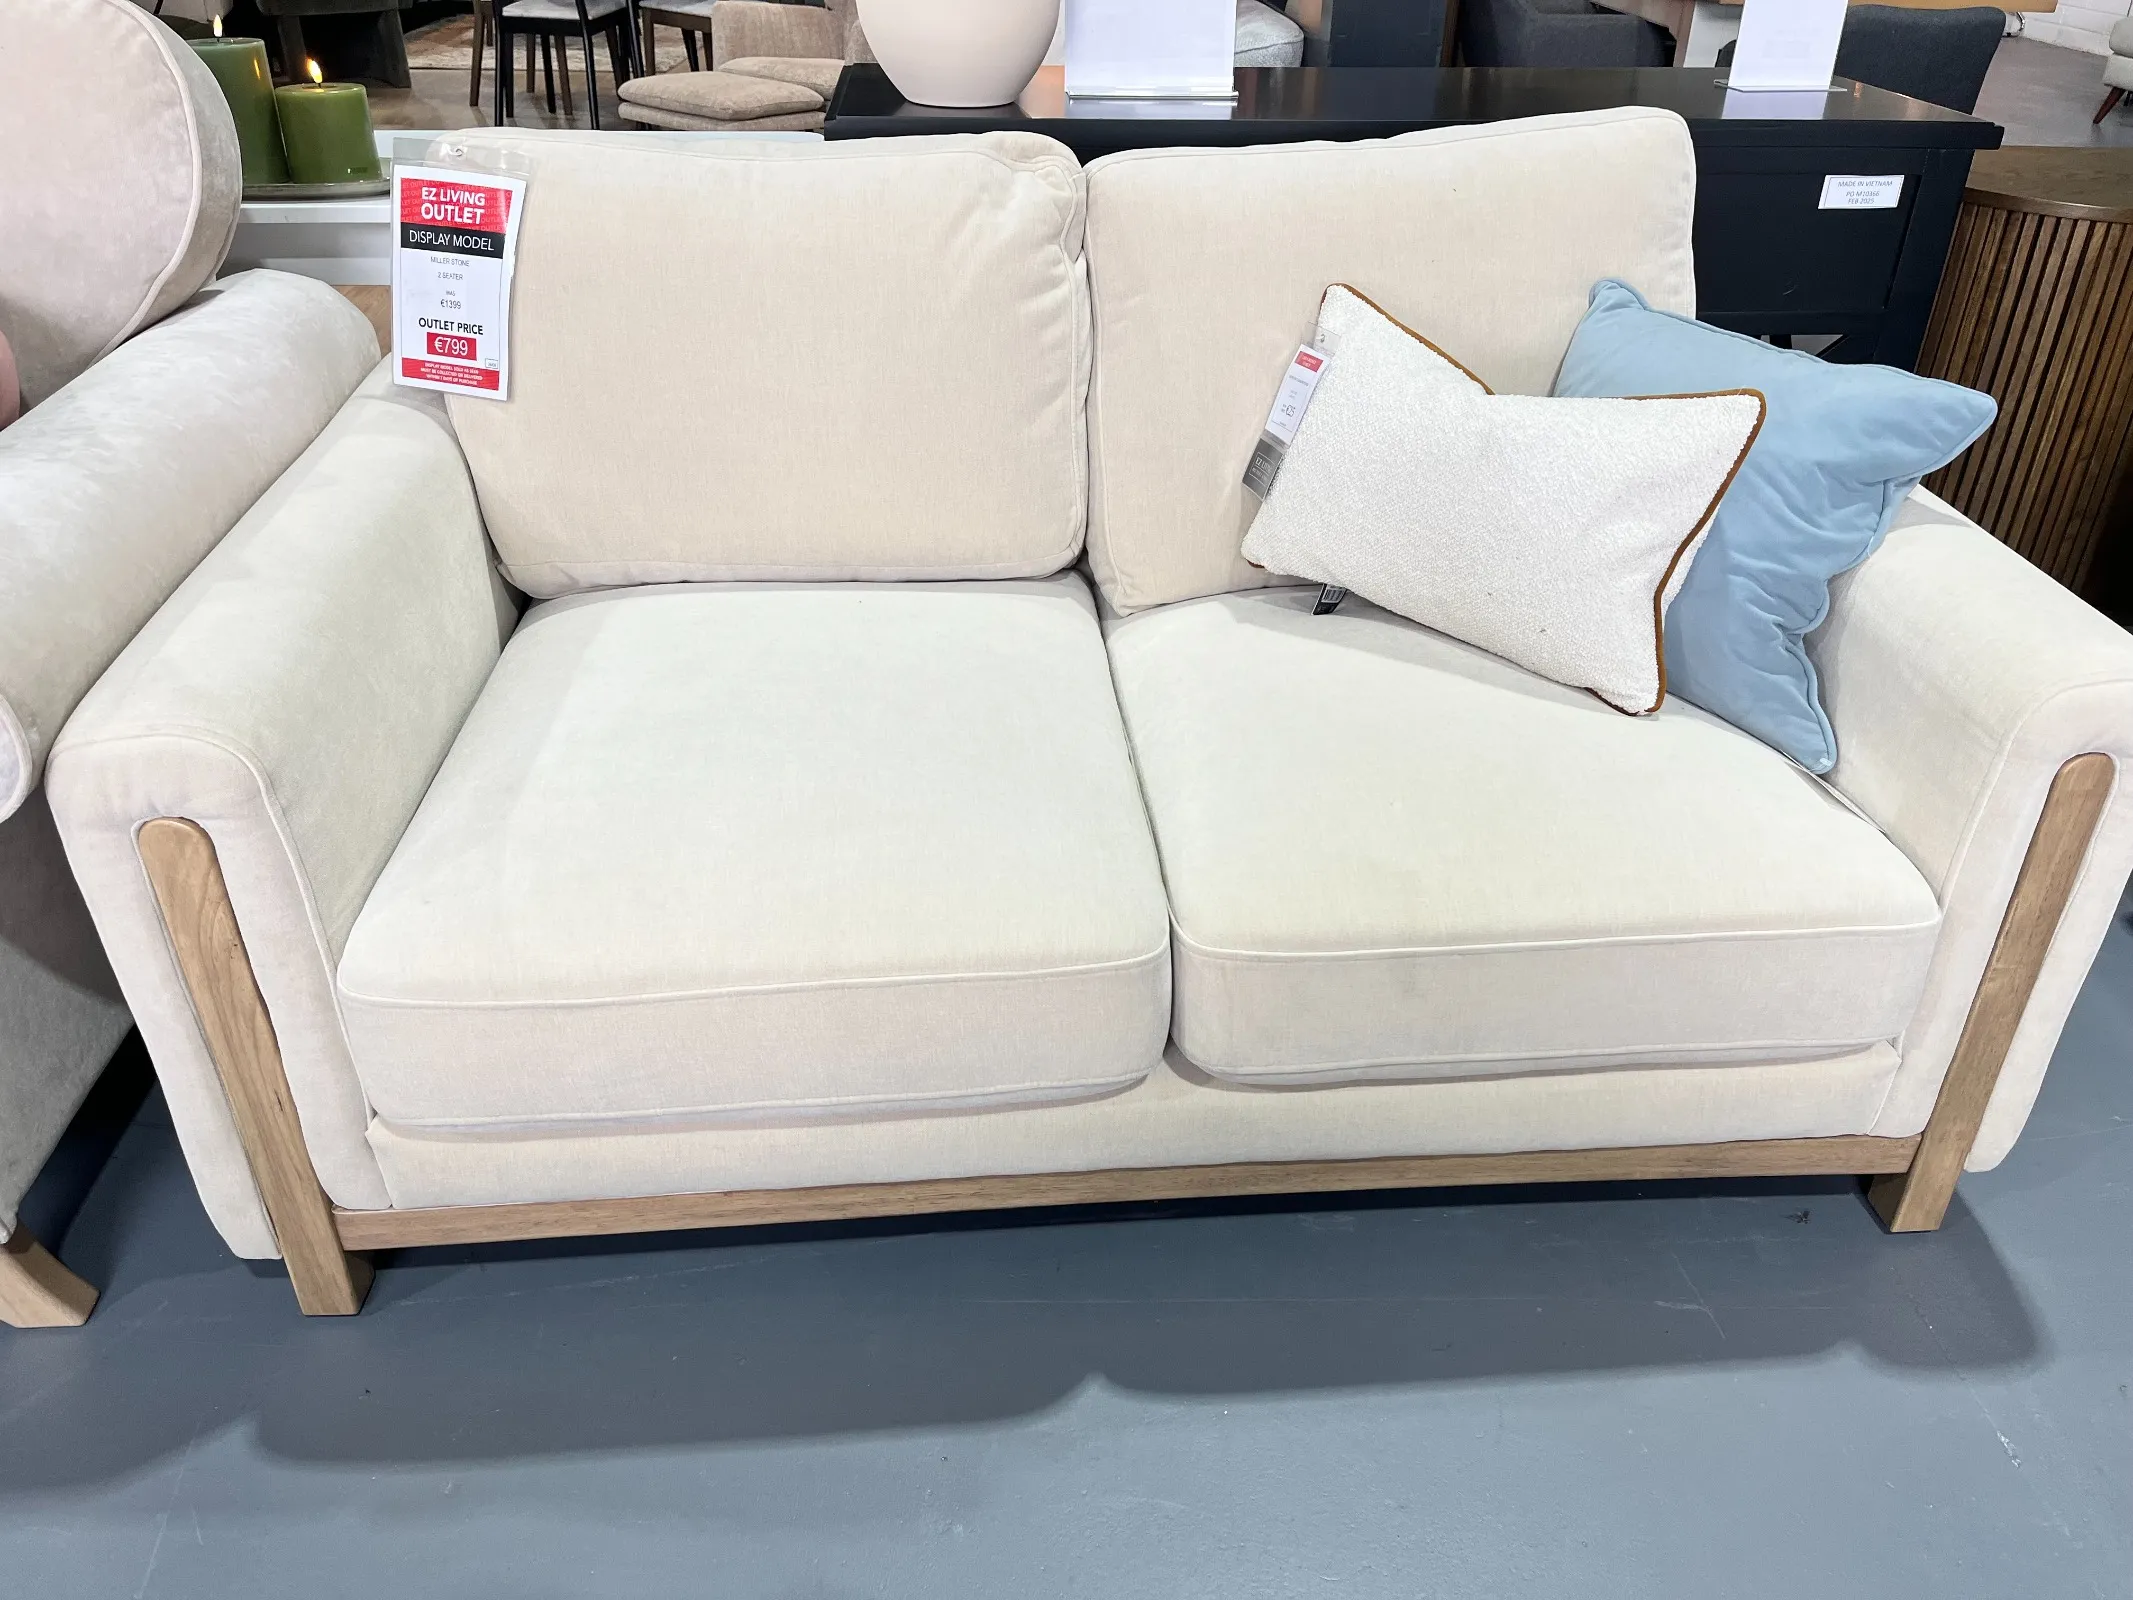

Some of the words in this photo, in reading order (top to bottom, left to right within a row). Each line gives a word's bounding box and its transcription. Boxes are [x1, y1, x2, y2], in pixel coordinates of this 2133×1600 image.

[421, 186, 437, 201] EZ
[440, 188, 485, 207] LIVING
[421, 202, 485, 225] OUTLET
[409, 229, 451, 246] DISPLAY
[453, 234, 495, 251] MODEL
[430, 256, 450, 265] MILLER
[451, 258, 470, 267] STONE
[442, 272, 463, 281] SEATER
[440, 298, 462, 310] €1399
[418, 317, 455, 332] OUTLET
[457, 322, 484, 335] PRICE
[434, 336, 468, 356] €799
